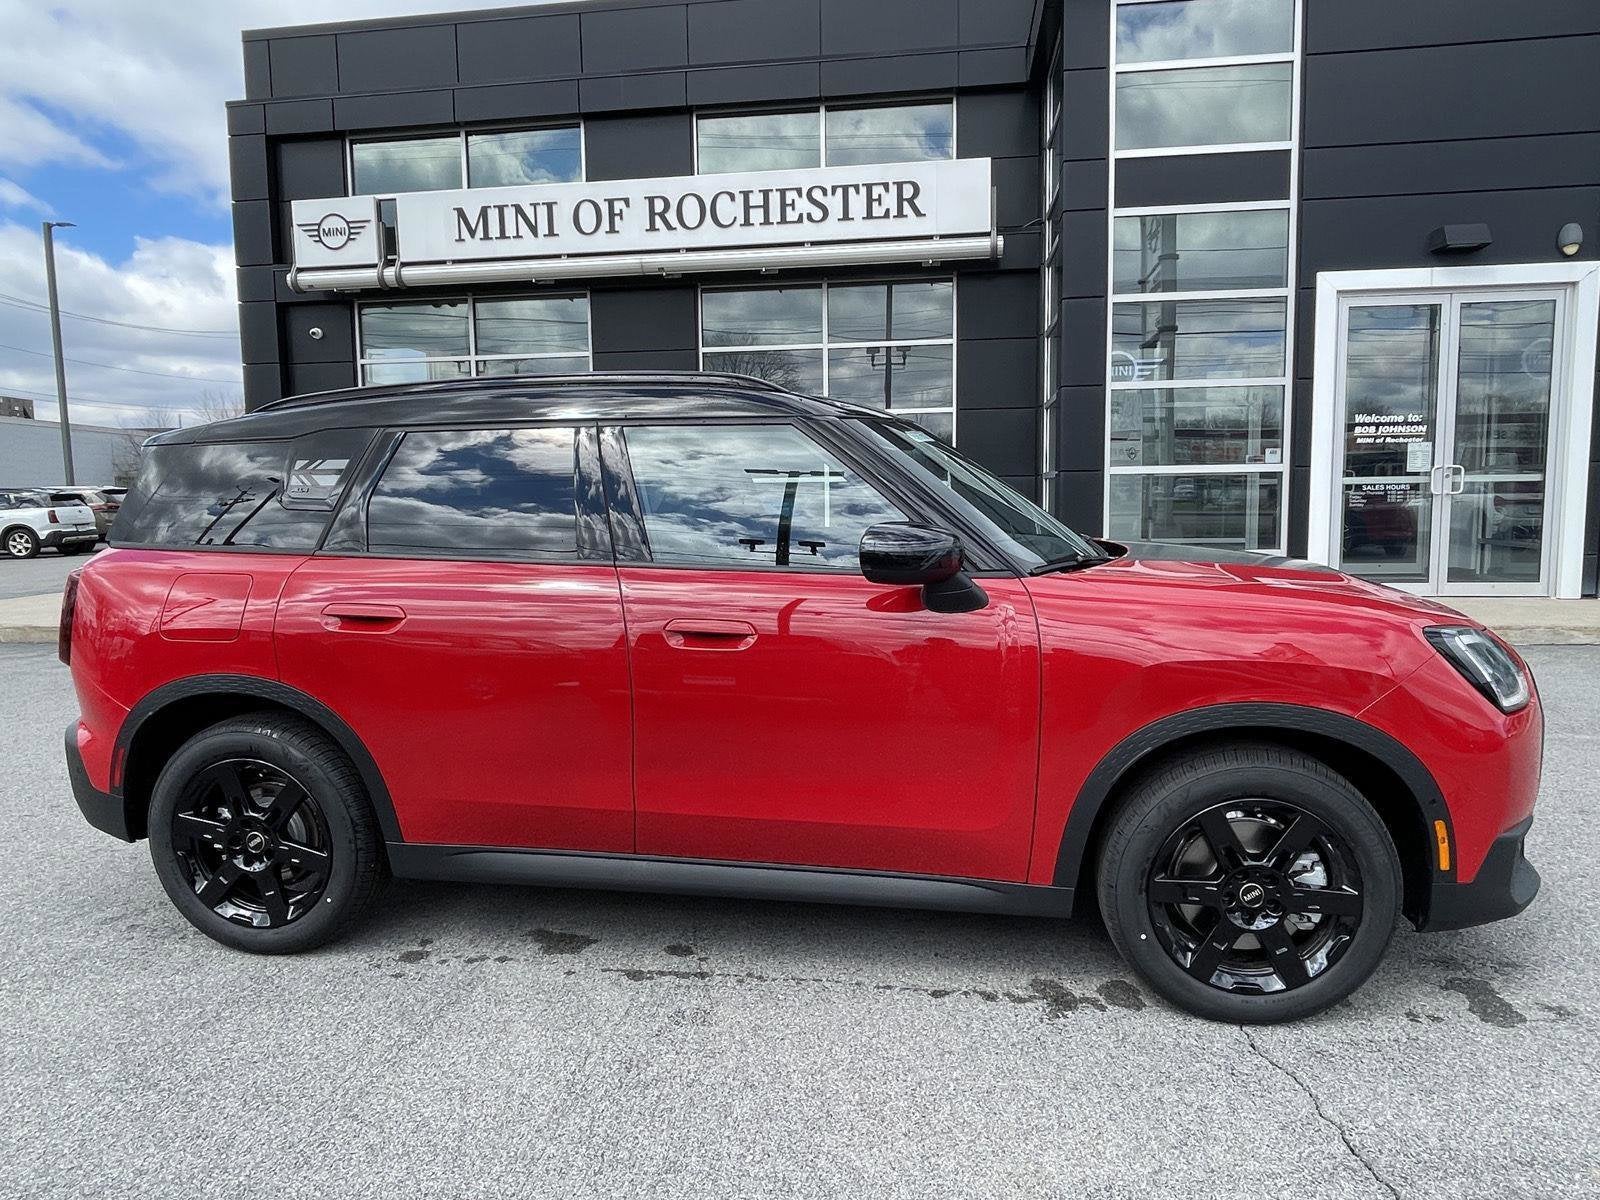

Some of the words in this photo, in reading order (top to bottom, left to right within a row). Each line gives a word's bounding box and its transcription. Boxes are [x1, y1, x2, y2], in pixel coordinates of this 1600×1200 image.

[453, 201, 559, 242] MINI
[572, 197, 630, 236] OF
[643, 180, 926, 231] ROCHESTER
[322, 227, 346, 237] MINI
[1354, 413, 1404, 423] Welcome
[1407, 413, 1423, 422] to:
[1354, 425, 1376, 434] BOB
[1376, 425, 1427, 435] JOHNSON
[1243, 888, 1261, 901] MINI
